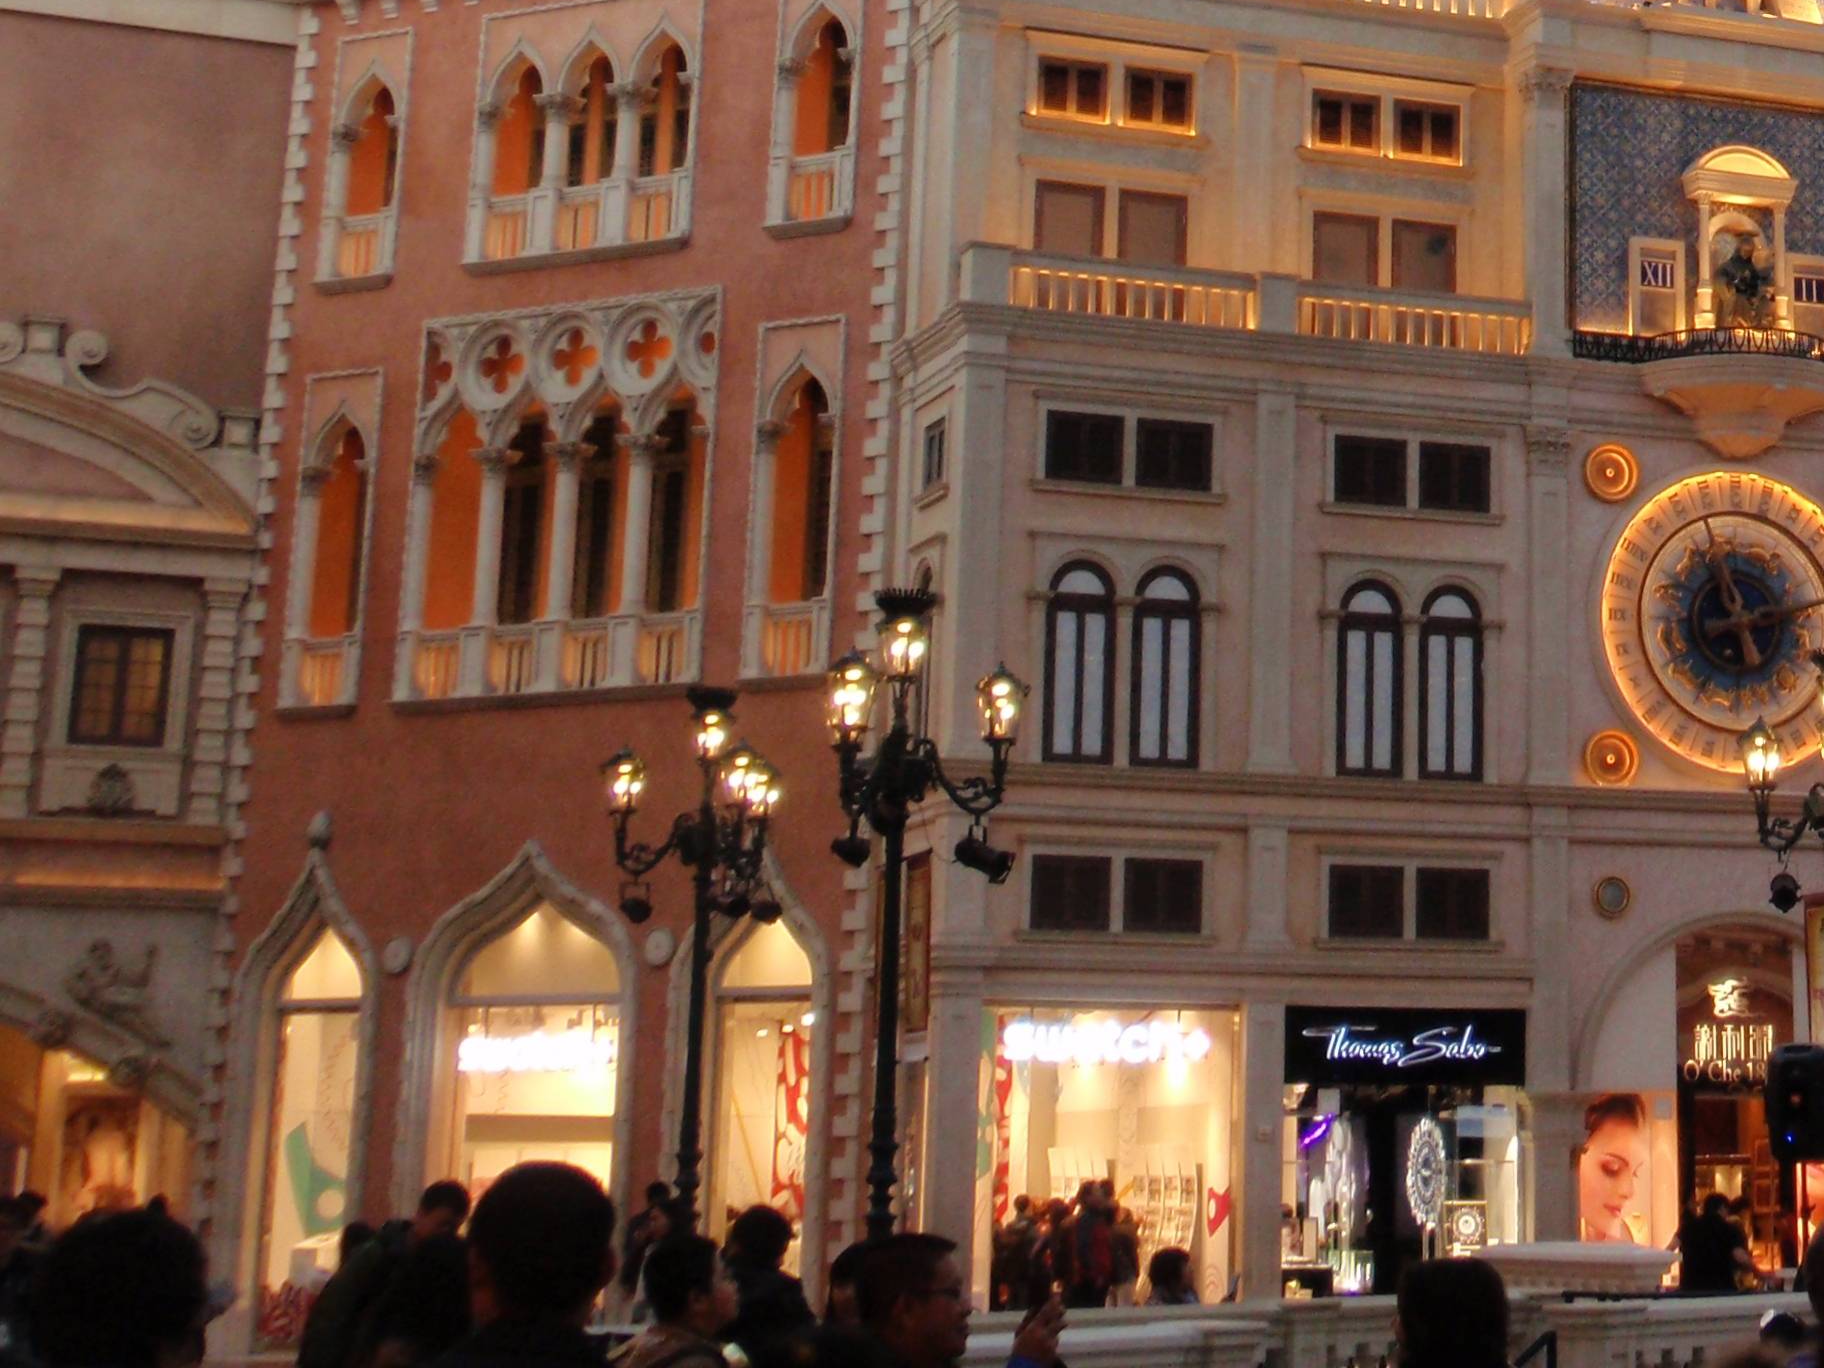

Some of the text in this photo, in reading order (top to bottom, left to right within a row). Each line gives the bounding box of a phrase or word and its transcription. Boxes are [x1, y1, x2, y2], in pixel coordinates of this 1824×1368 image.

[1644, 262, 1671, 287] XII
[1302, 1022, 1501, 1067] Thomas Sabo
[1746, 1060, 1767, 1082] 18
